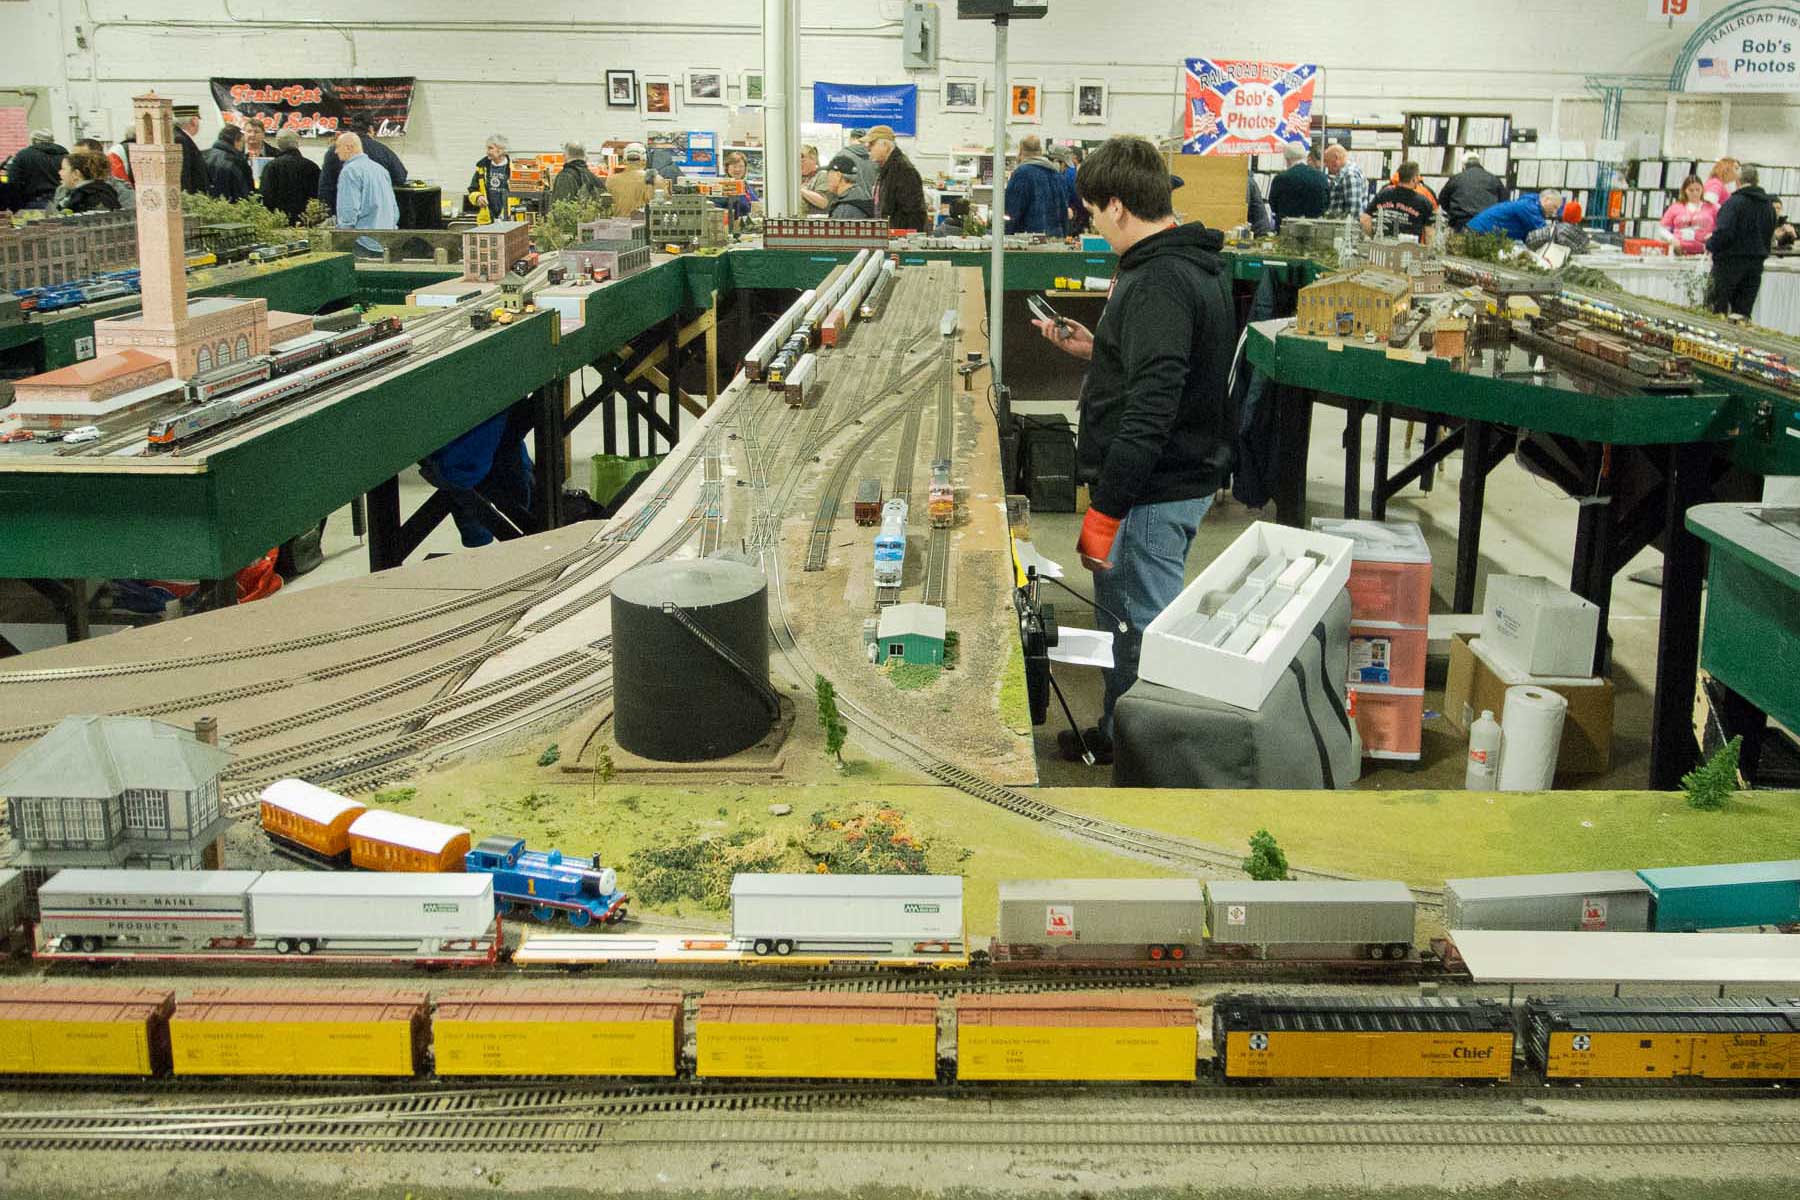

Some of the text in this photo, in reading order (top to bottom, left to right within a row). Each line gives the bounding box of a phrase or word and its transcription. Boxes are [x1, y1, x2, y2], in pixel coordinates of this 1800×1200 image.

[1709, 13, 1800, 45] RAILROAD HIS
[1742, 39, 1792, 54] Bob's
[1734, 58, 1796, 73] Photos
[1200, 64, 1258, 89] RAILROAD
[1234, 88, 1275, 107] Bob's
[1227, 112, 1277, 129] Photos
[528, 879, 536, 895] 1
[88, 897, 128, 906] STATE
[153, 898, 195, 907] MAINE
[108, 921, 179, 931] PRODUCTS
[1453, 1045, 1494, 1059] Chief
